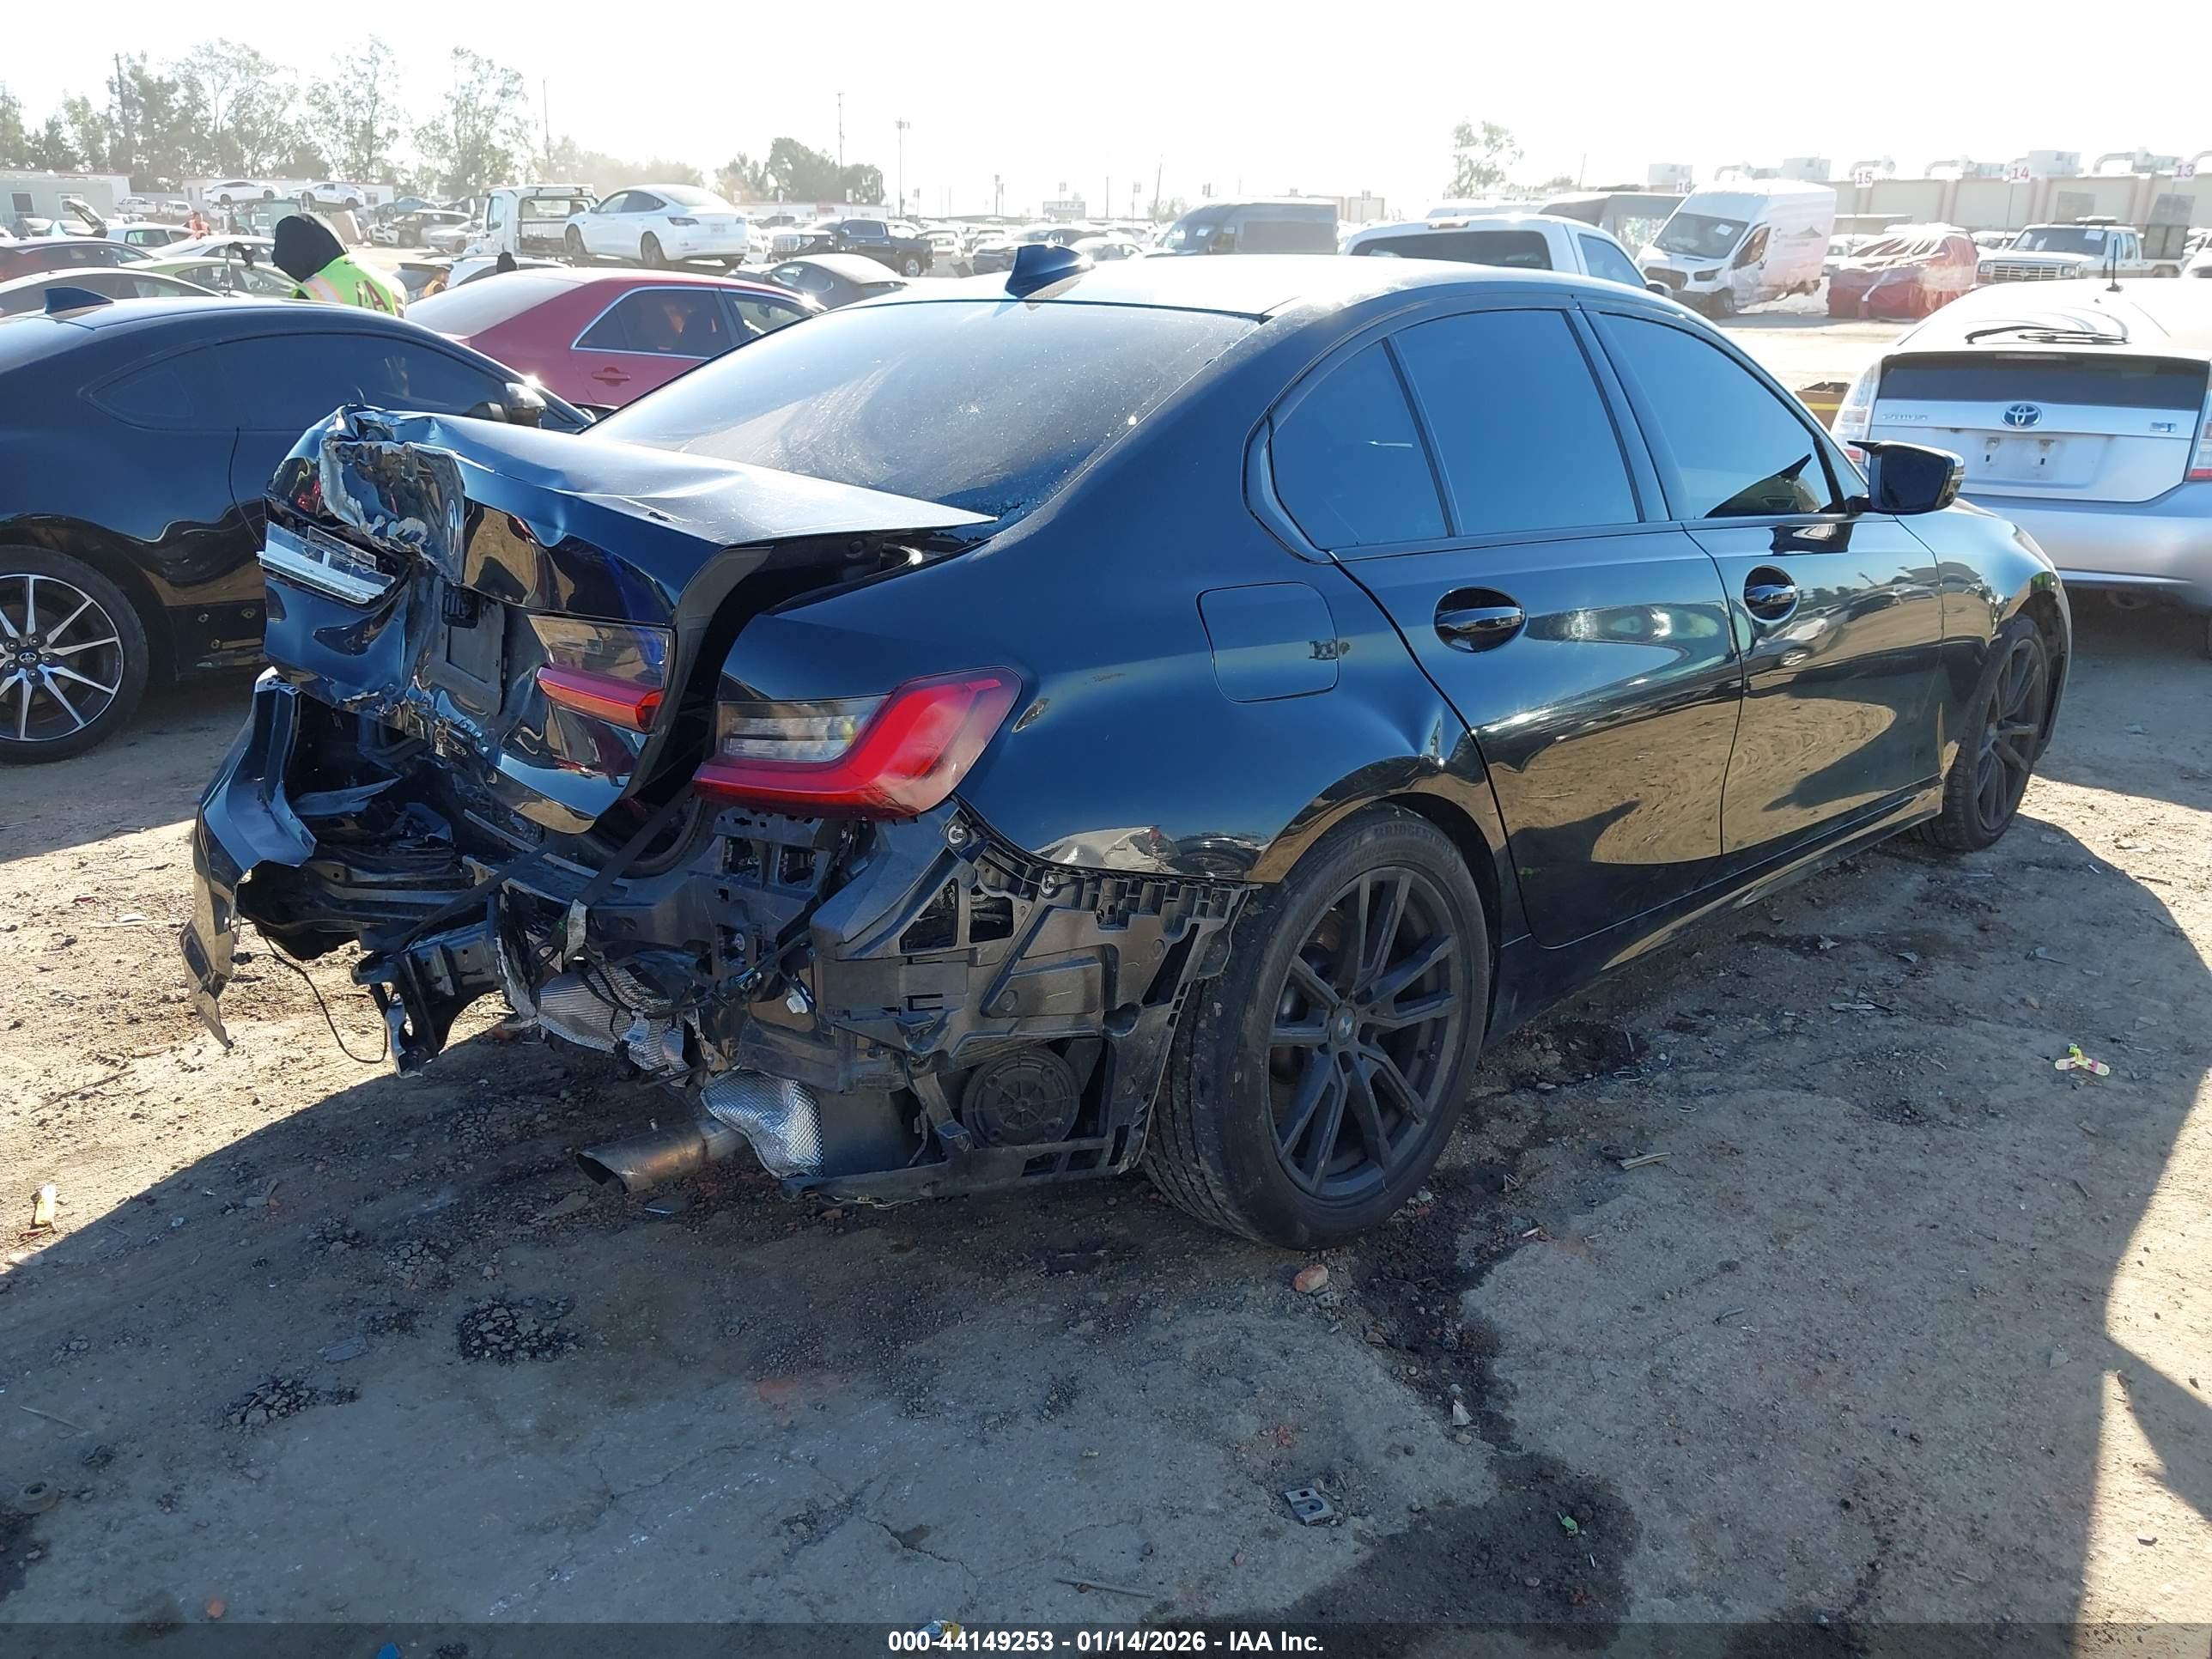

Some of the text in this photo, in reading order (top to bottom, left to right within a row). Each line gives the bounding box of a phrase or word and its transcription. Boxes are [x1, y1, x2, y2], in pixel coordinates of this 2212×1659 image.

[2012, 166, 2029, 179] 14
[2175, 163, 2196, 178] 13
[1857, 172, 1873, 185] 15
